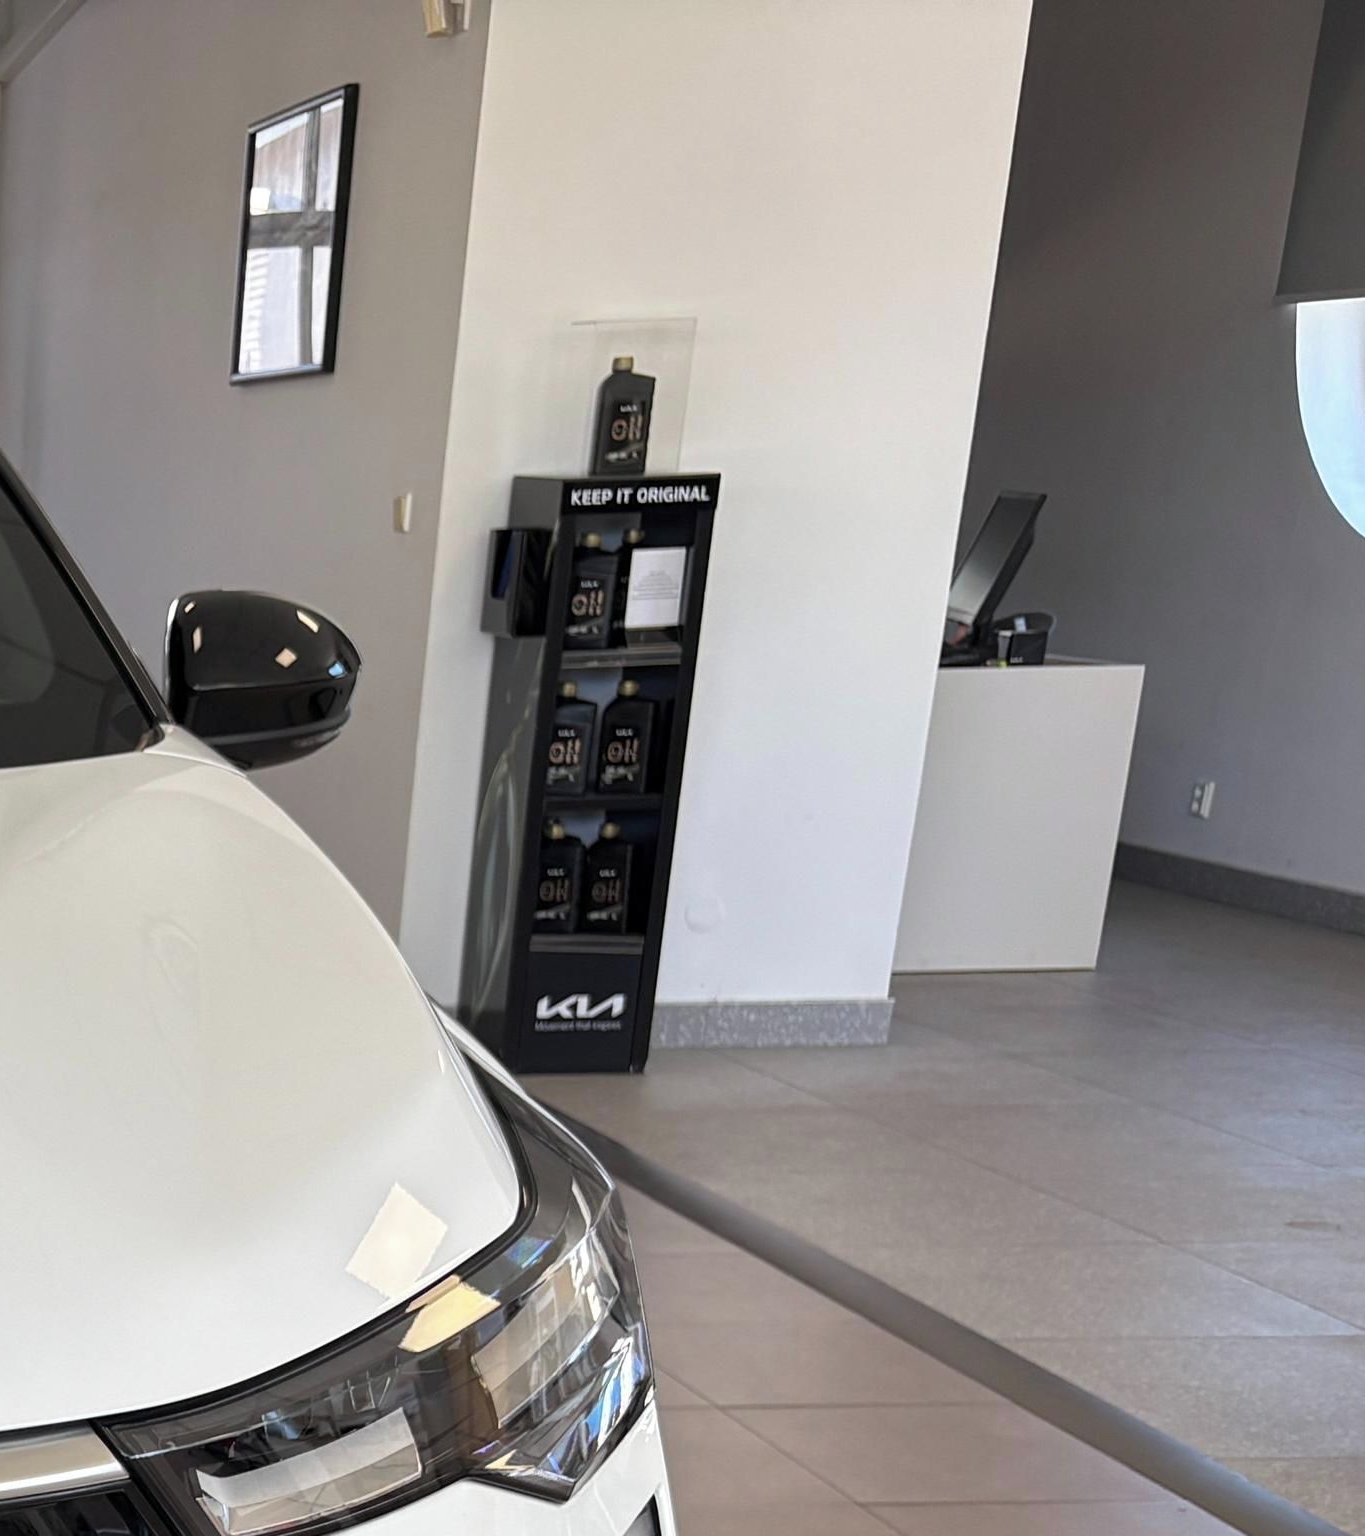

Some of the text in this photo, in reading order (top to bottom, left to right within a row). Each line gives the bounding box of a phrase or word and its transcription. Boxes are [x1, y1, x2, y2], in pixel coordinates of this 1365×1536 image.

[571, 485, 710, 506] KEEP IT ORIGINAL
